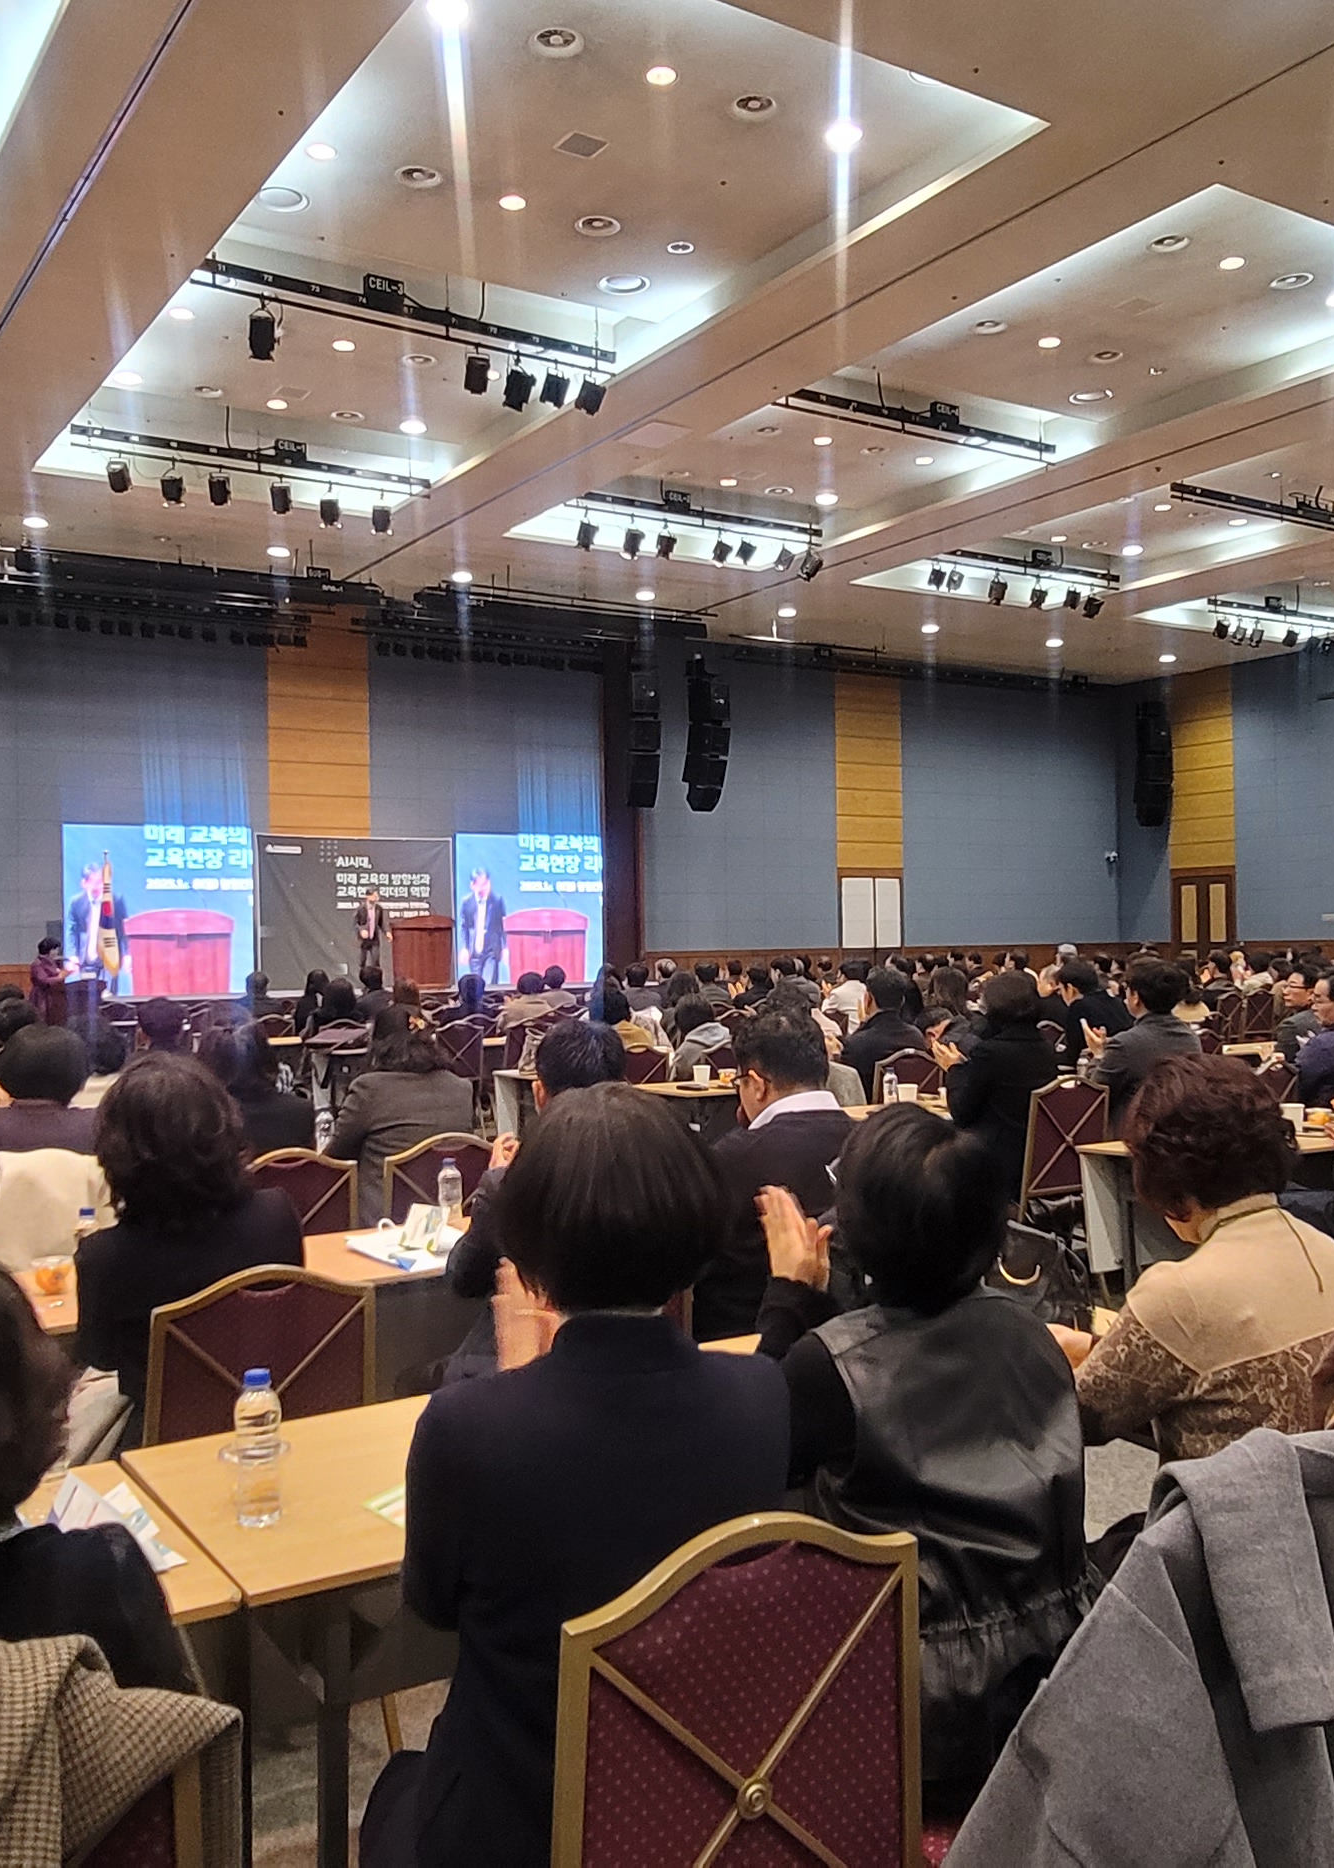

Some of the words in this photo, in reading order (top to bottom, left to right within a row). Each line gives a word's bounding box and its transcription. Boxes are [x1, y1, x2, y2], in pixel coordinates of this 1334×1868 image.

[369, 276, 404, 295] CEIL-3
[278, 439, 307, 453] CEIL-1
[144, 824, 185, 844] 미래
[189, 825, 247, 845] 교육의
[519, 834, 551, 852] 미래
[553, 835, 599, 853] 교육의
[145, 847, 225, 870] 교육현장
[228, 848, 253, 870] 리
[336, 855, 373, 869] AI시대,
[519, 854, 581, 874] 교육현장
[584, 855, 603, 874] 리
[336, 873, 357, 885] 미래
[359, 873, 389, 885] 교육의
[391, 873, 430, 885] 방향성과
[336, 886, 367, 898] 교육현
[379, 886, 408, 898] 리더의
